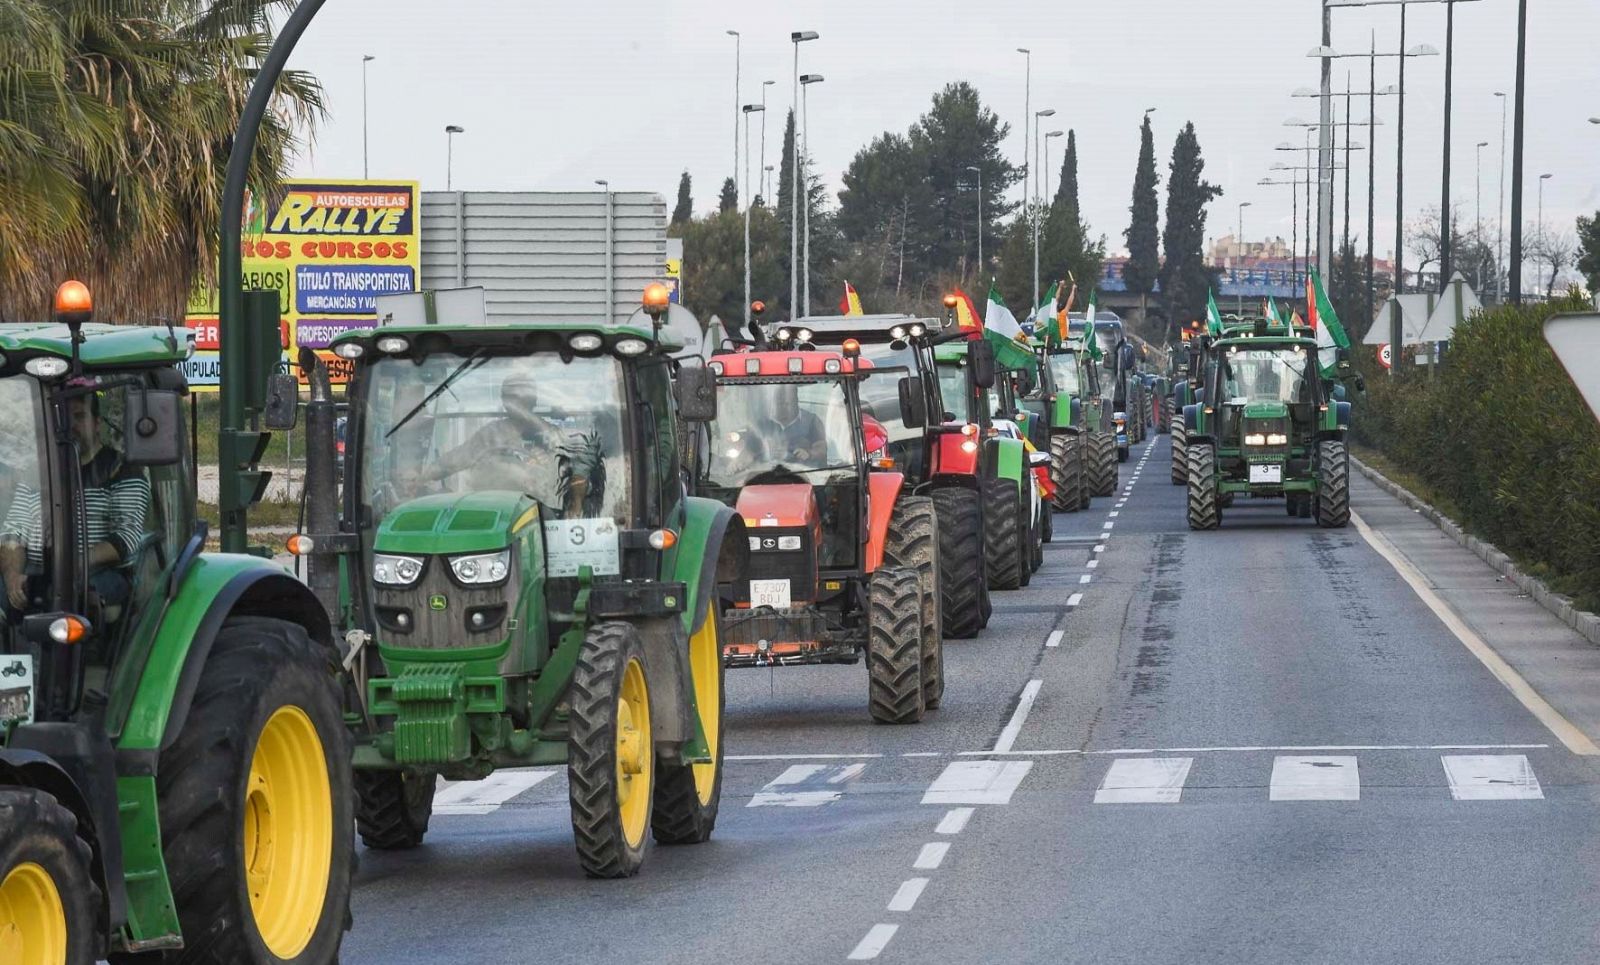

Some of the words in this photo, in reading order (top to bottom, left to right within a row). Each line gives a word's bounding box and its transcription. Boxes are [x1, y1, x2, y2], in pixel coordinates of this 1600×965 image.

[316, 196, 406, 207] AUTOESCUELAS
[270, 194, 405, 233] RALLYE
[301, 241, 408, 259] CURSOS
[298, 268, 331, 291] TÍTULO
[332, 273, 411, 291] TRANSPORTISTA
[307, 293, 356, 309] MERCANCÍAS
[358, 296, 363, 309] Y
[365, 296, 377, 309] VIA
[1262, 465, 1269, 473] 3
[570, 525, 585, 545] 3
